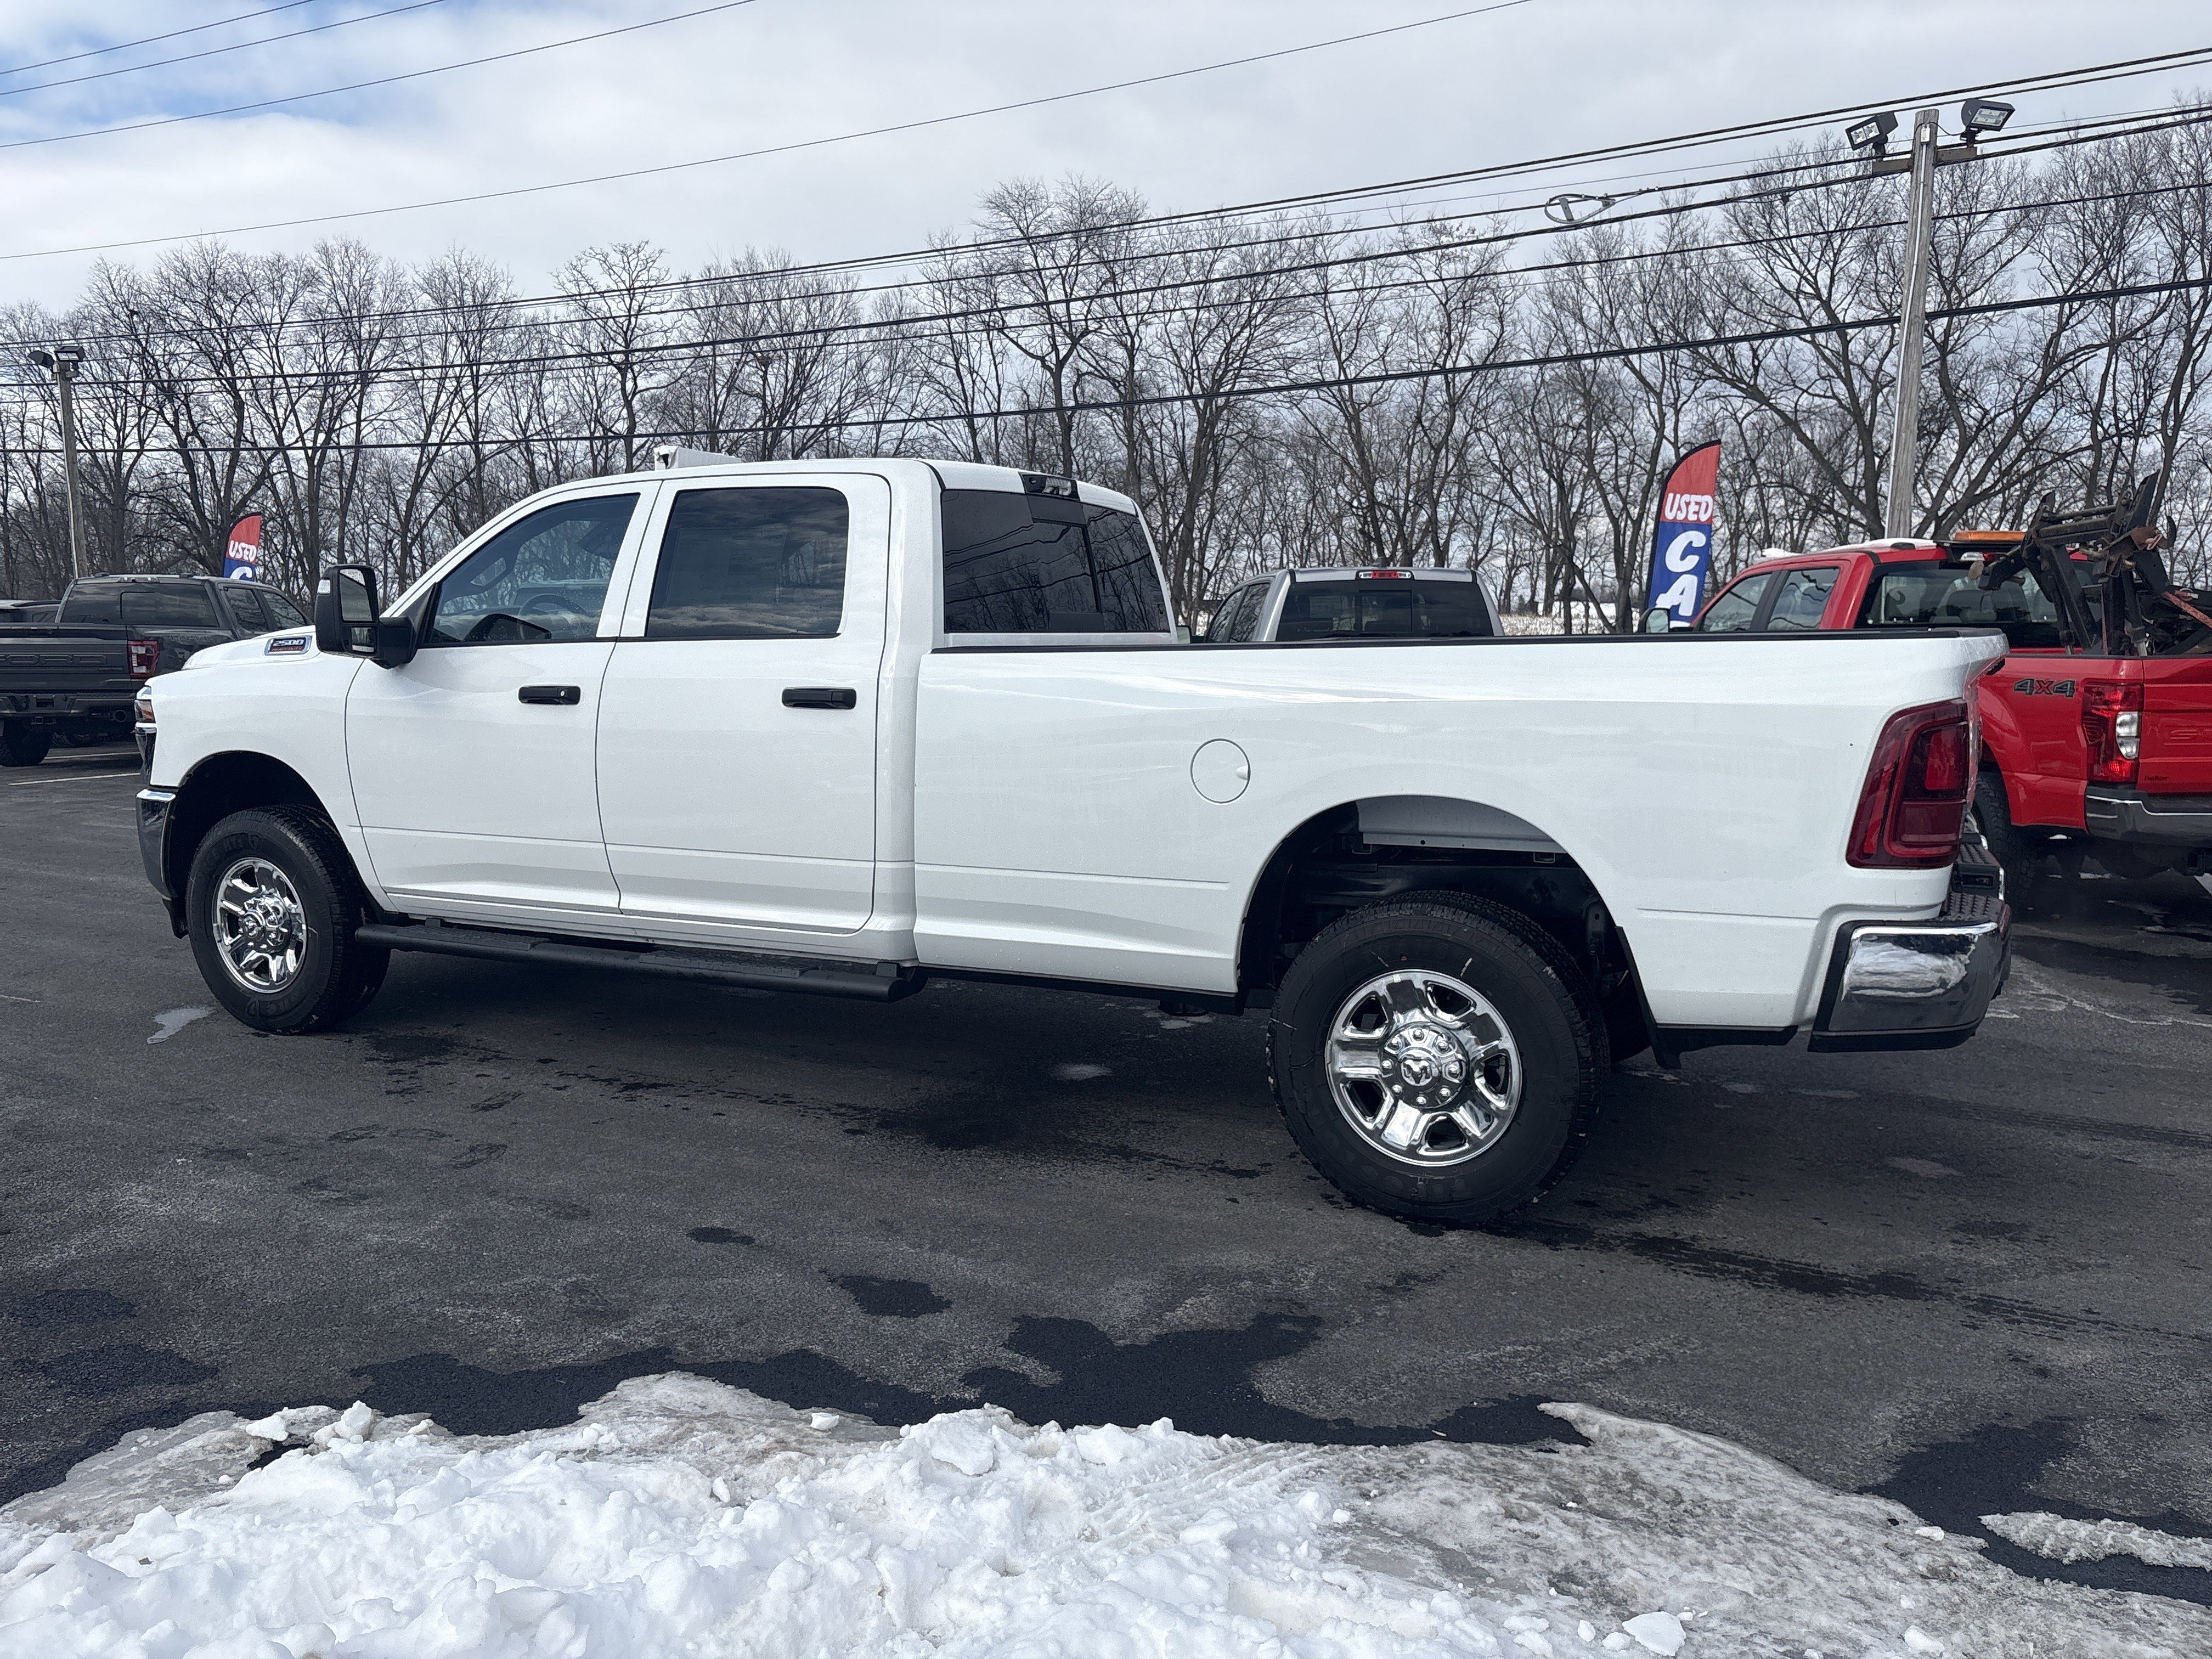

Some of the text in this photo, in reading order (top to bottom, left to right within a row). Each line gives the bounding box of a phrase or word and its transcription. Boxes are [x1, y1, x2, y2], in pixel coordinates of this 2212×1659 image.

[1664, 493, 1713, 521] USED
[229, 540, 257, 562] USED
[1656, 531, 1706, 627] CA
[0, 654, 108, 664] ORD
